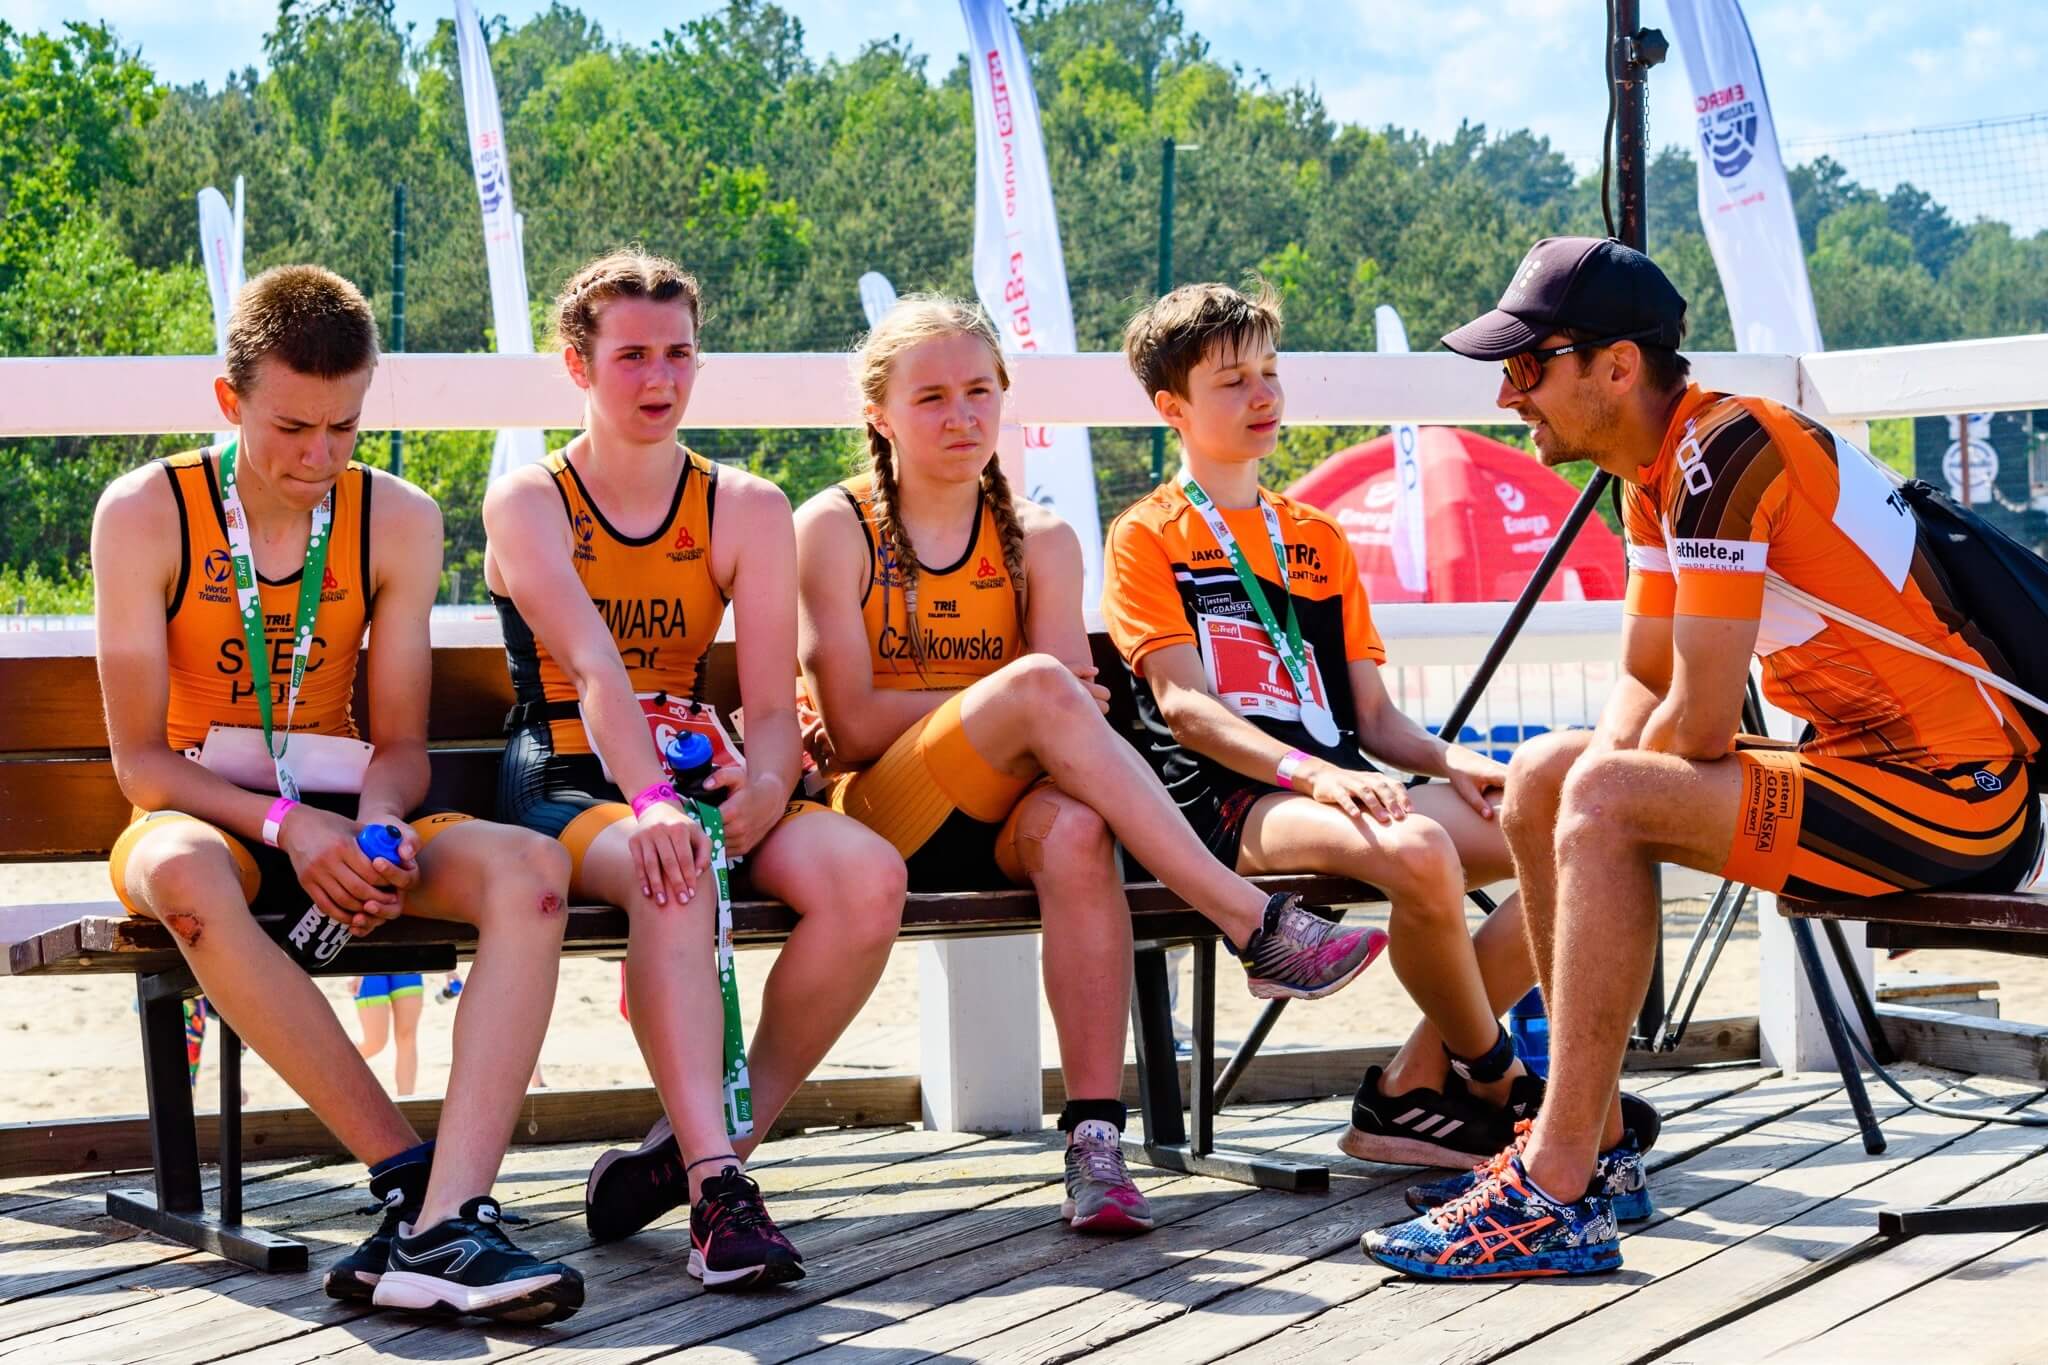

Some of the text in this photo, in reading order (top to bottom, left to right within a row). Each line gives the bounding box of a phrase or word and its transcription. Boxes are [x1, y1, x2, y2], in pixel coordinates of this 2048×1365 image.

[1192, 549, 1225, 561] JAKO
[205, 583, 228, 594] World
[199, 592, 231, 603] Triathlon
[1207, 597, 1230, 606] jestem
[216, 637, 327, 675] SEC
[1257, 650, 1280, 685] 7
[1258, 682, 1293, 699] TYMON
[1779, 770, 1789, 814] jestem
[1749, 806, 1757, 832] sport
